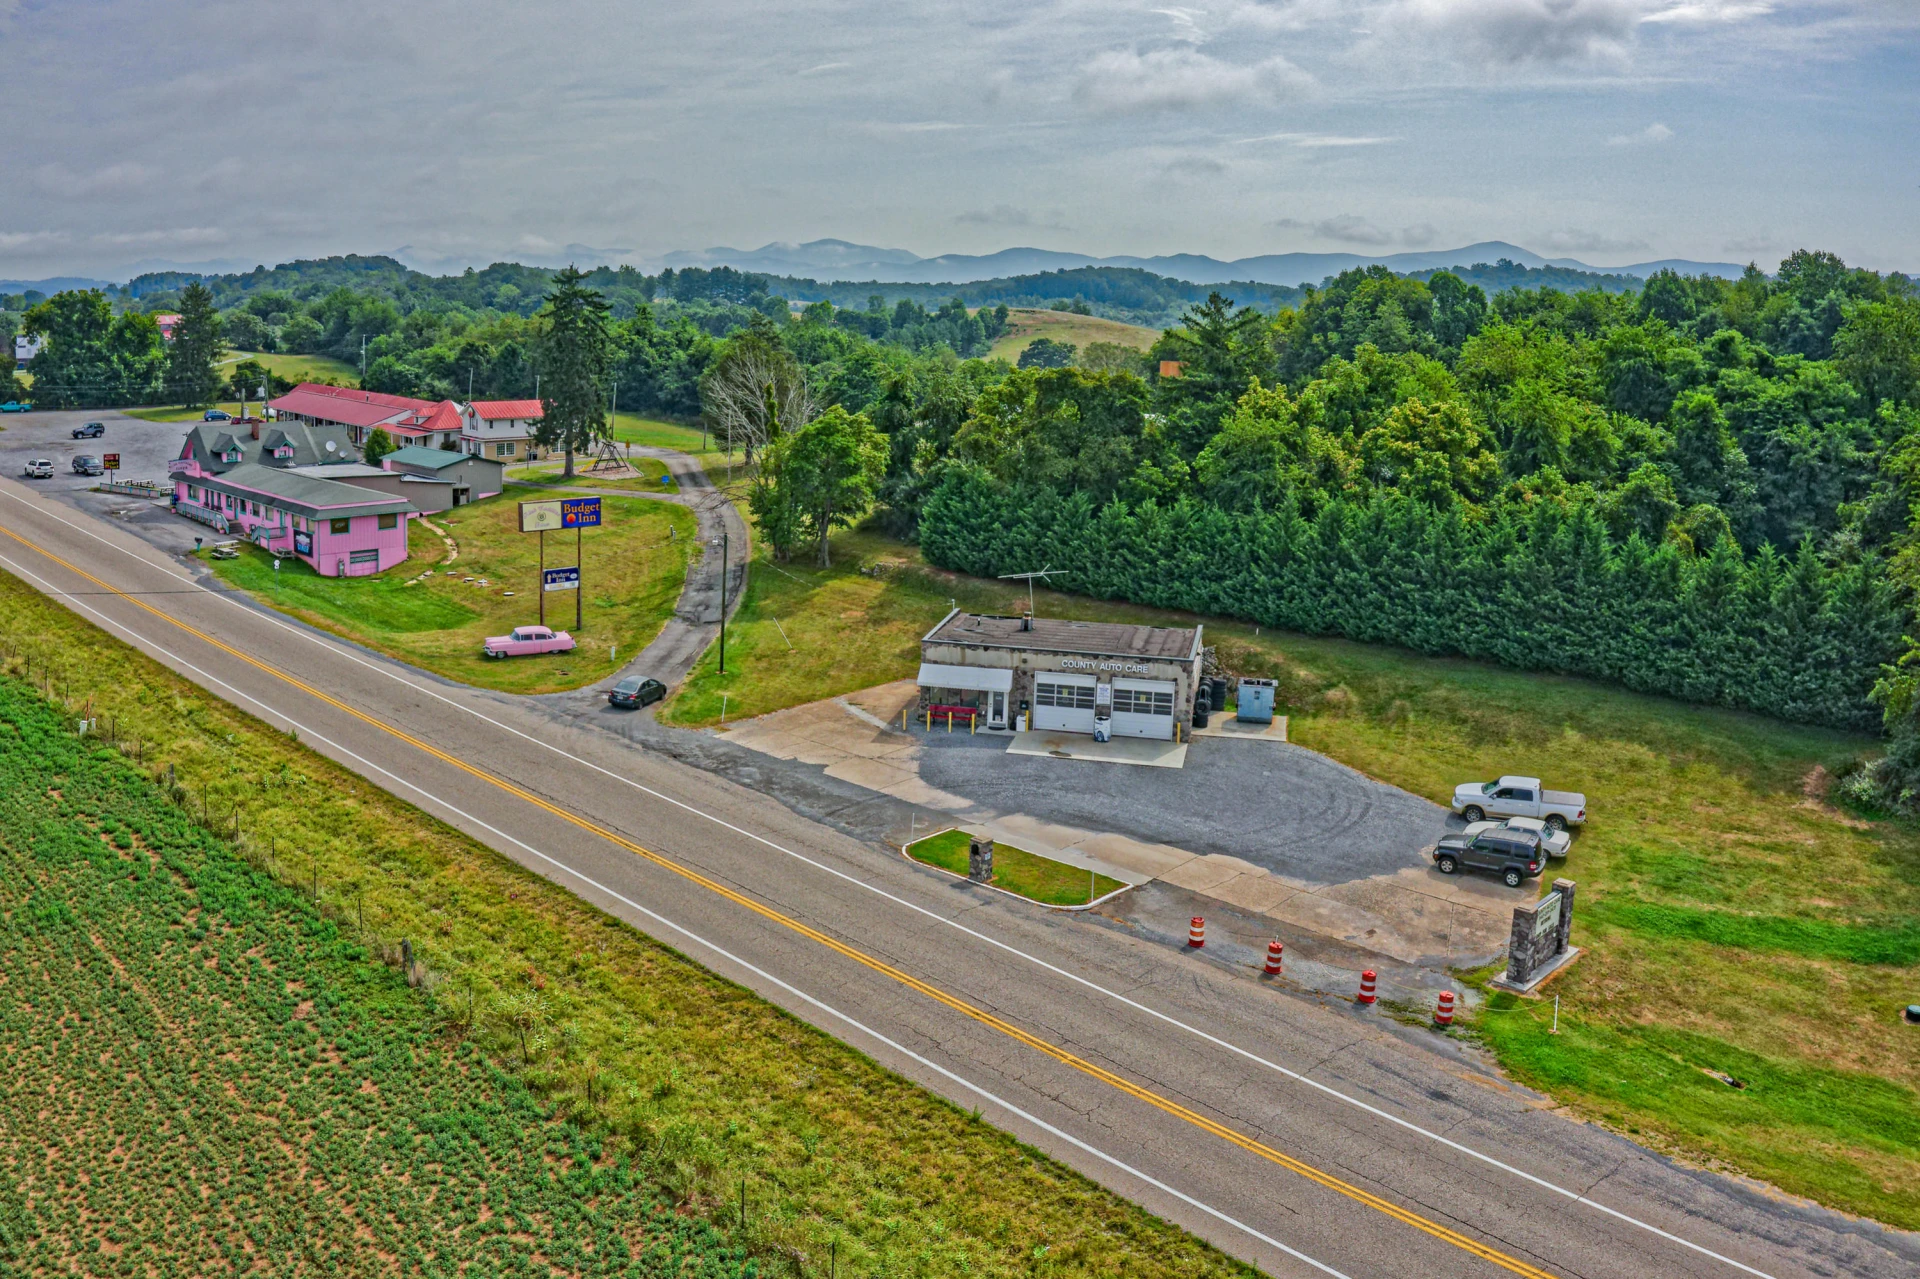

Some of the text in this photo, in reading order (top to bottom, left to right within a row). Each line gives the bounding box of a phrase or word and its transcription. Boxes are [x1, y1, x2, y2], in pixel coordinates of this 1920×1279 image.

[564, 502, 600, 514] Budget
[578, 513, 596, 522] Inn
[1061, 660, 1148, 674] COUNTY AUTO CARE
